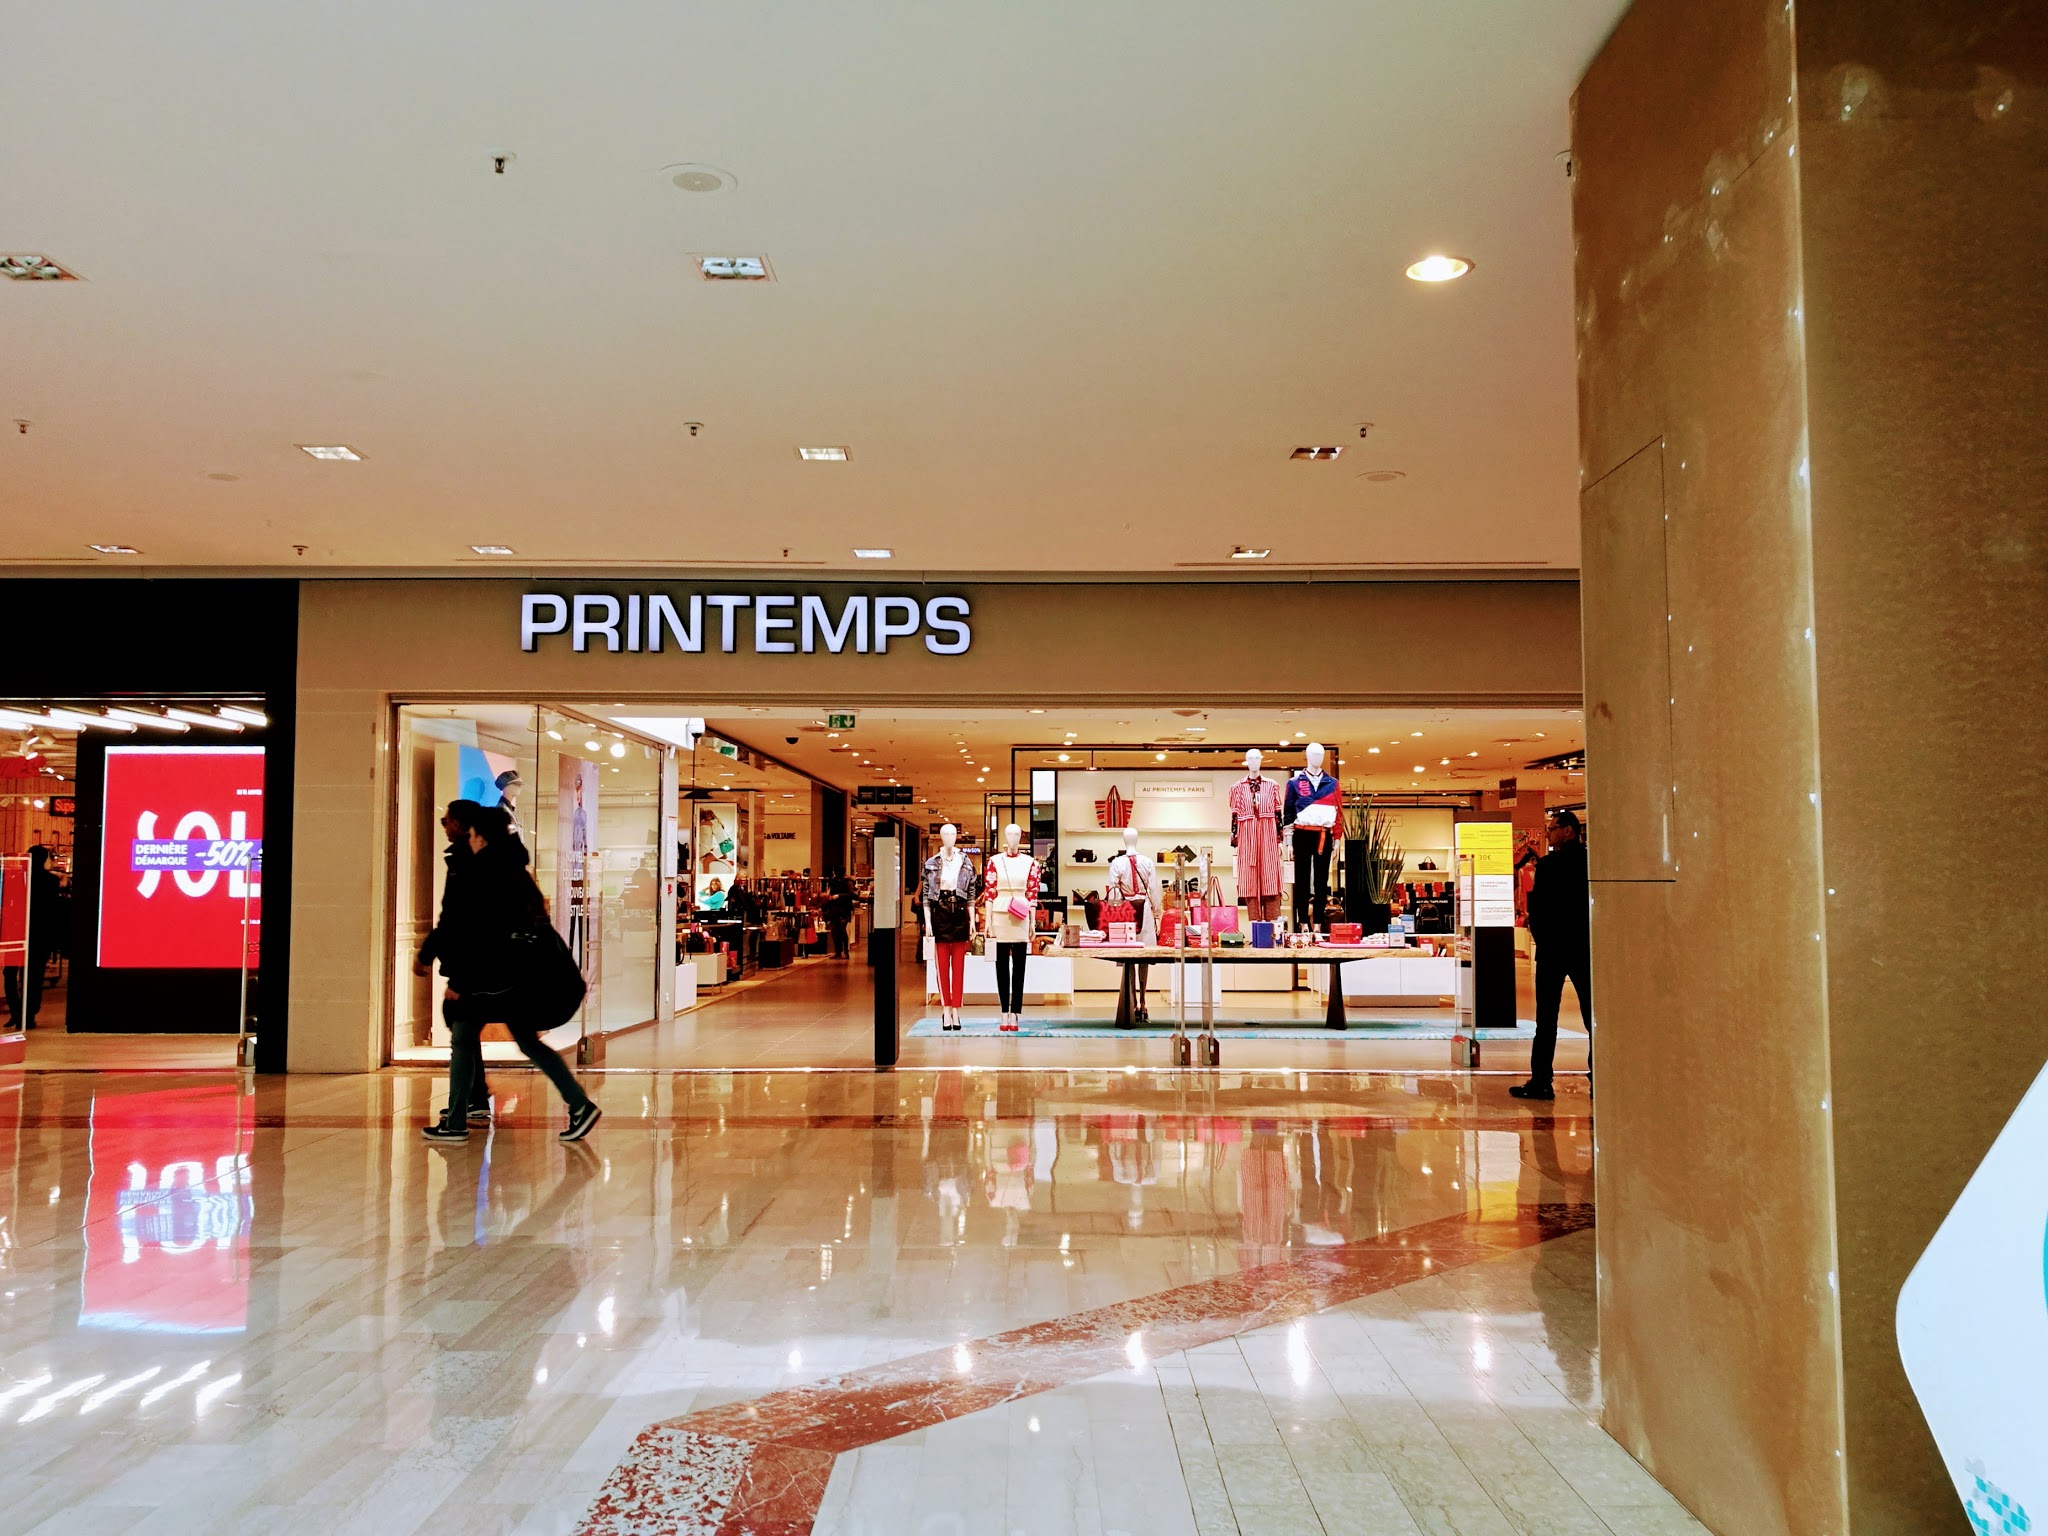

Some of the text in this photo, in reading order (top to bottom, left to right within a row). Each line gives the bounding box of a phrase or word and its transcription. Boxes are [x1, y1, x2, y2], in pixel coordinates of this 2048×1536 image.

[521, 594, 972, 655] PRINTEMPS
[135, 842, 188, 855] DERNIÈRE
[135, 855, 188, 866] DÉMARQUE
